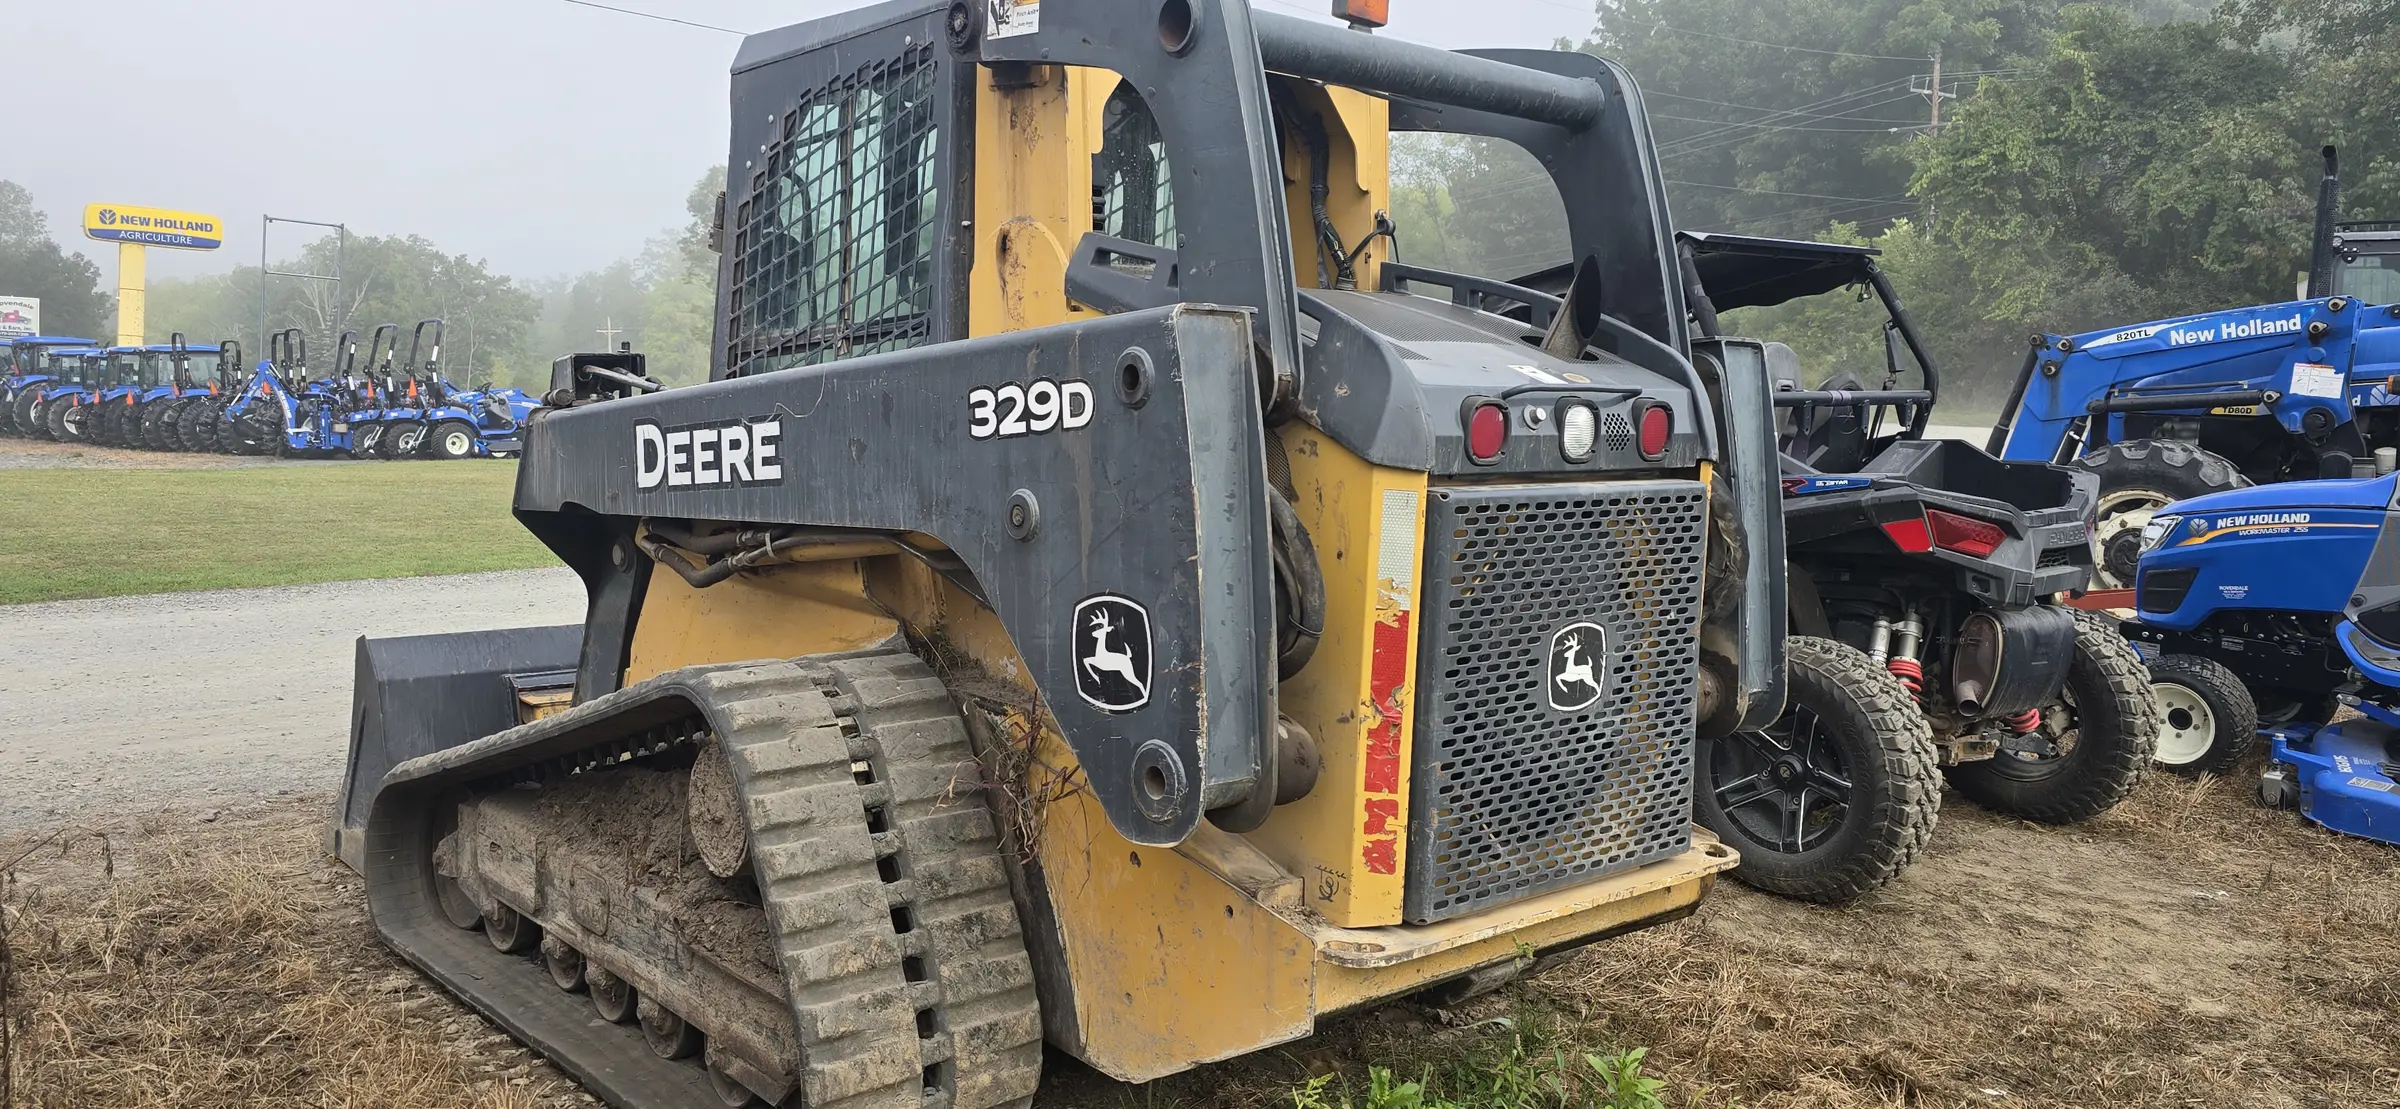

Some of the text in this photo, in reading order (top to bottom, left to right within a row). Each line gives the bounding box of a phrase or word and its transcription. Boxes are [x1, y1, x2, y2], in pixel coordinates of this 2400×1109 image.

[120, 215, 213, 232] NEW HOLLAND
[119, 230, 193, 245] AGRICULTURE
[2116, 328, 2152, 342] 820TL
[2170, 314, 2302, 346] New Holland
[968, 379, 1094, 439] 329D
[635, 419, 783, 489] DEERE
[2217, 513, 2310, 529] NEW HOLLAND
[2239, 527, 2290, 536] WORKMASTER
